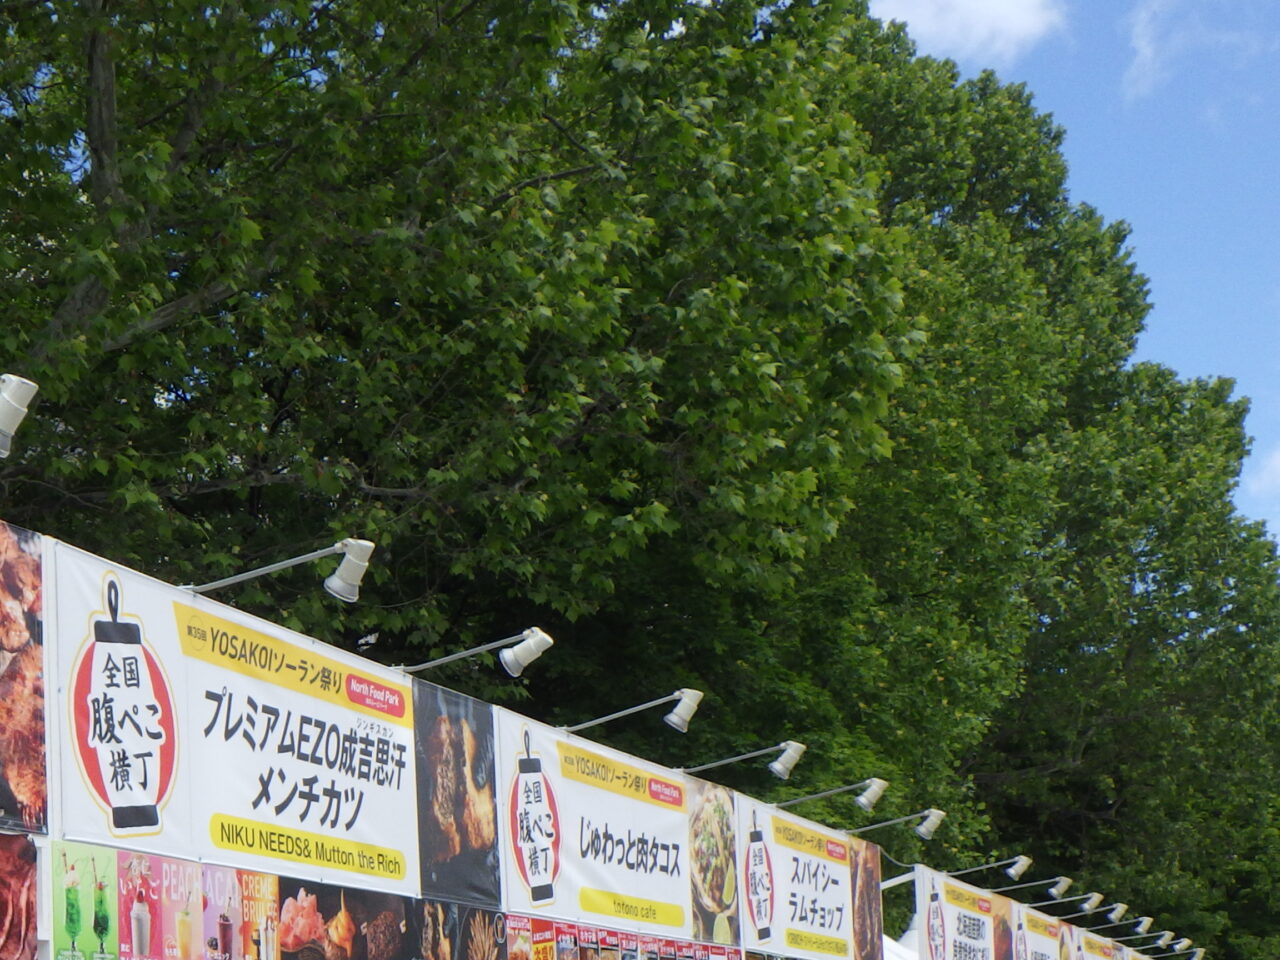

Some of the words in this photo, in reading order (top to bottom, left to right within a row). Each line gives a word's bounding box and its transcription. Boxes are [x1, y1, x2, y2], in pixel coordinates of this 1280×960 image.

[102, 653, 141, 689] 全国
[210, 627, 343, 695] YOSAKOIソーラン祭り
[91, 691, 163, 746] 腹ぺこ
[203, 686, 406, 790] プレミアムEZO成吉思汗
[109, 749, 153, 792] 横丁
[252, 767, 365, 831] メンチカツ
[523, 780, 542, 805] 全国
[519, 808, 555, 843] 腹ぺこ
[220, 822, 255, 848] NIKU
[315, 838, 355, 867] Mutton
[357, 847, 375, 870] the
[377, 853, 401, 874] Rich
[528, 846, 550, 876] 横丁
[580, 816, 681, 878] じゅわっと肉タコス
[791, 856, 840, 892] スパイシー
[641, 904, 657, 920] cafe
[789, 892, 844, 931] ラムチョップ
